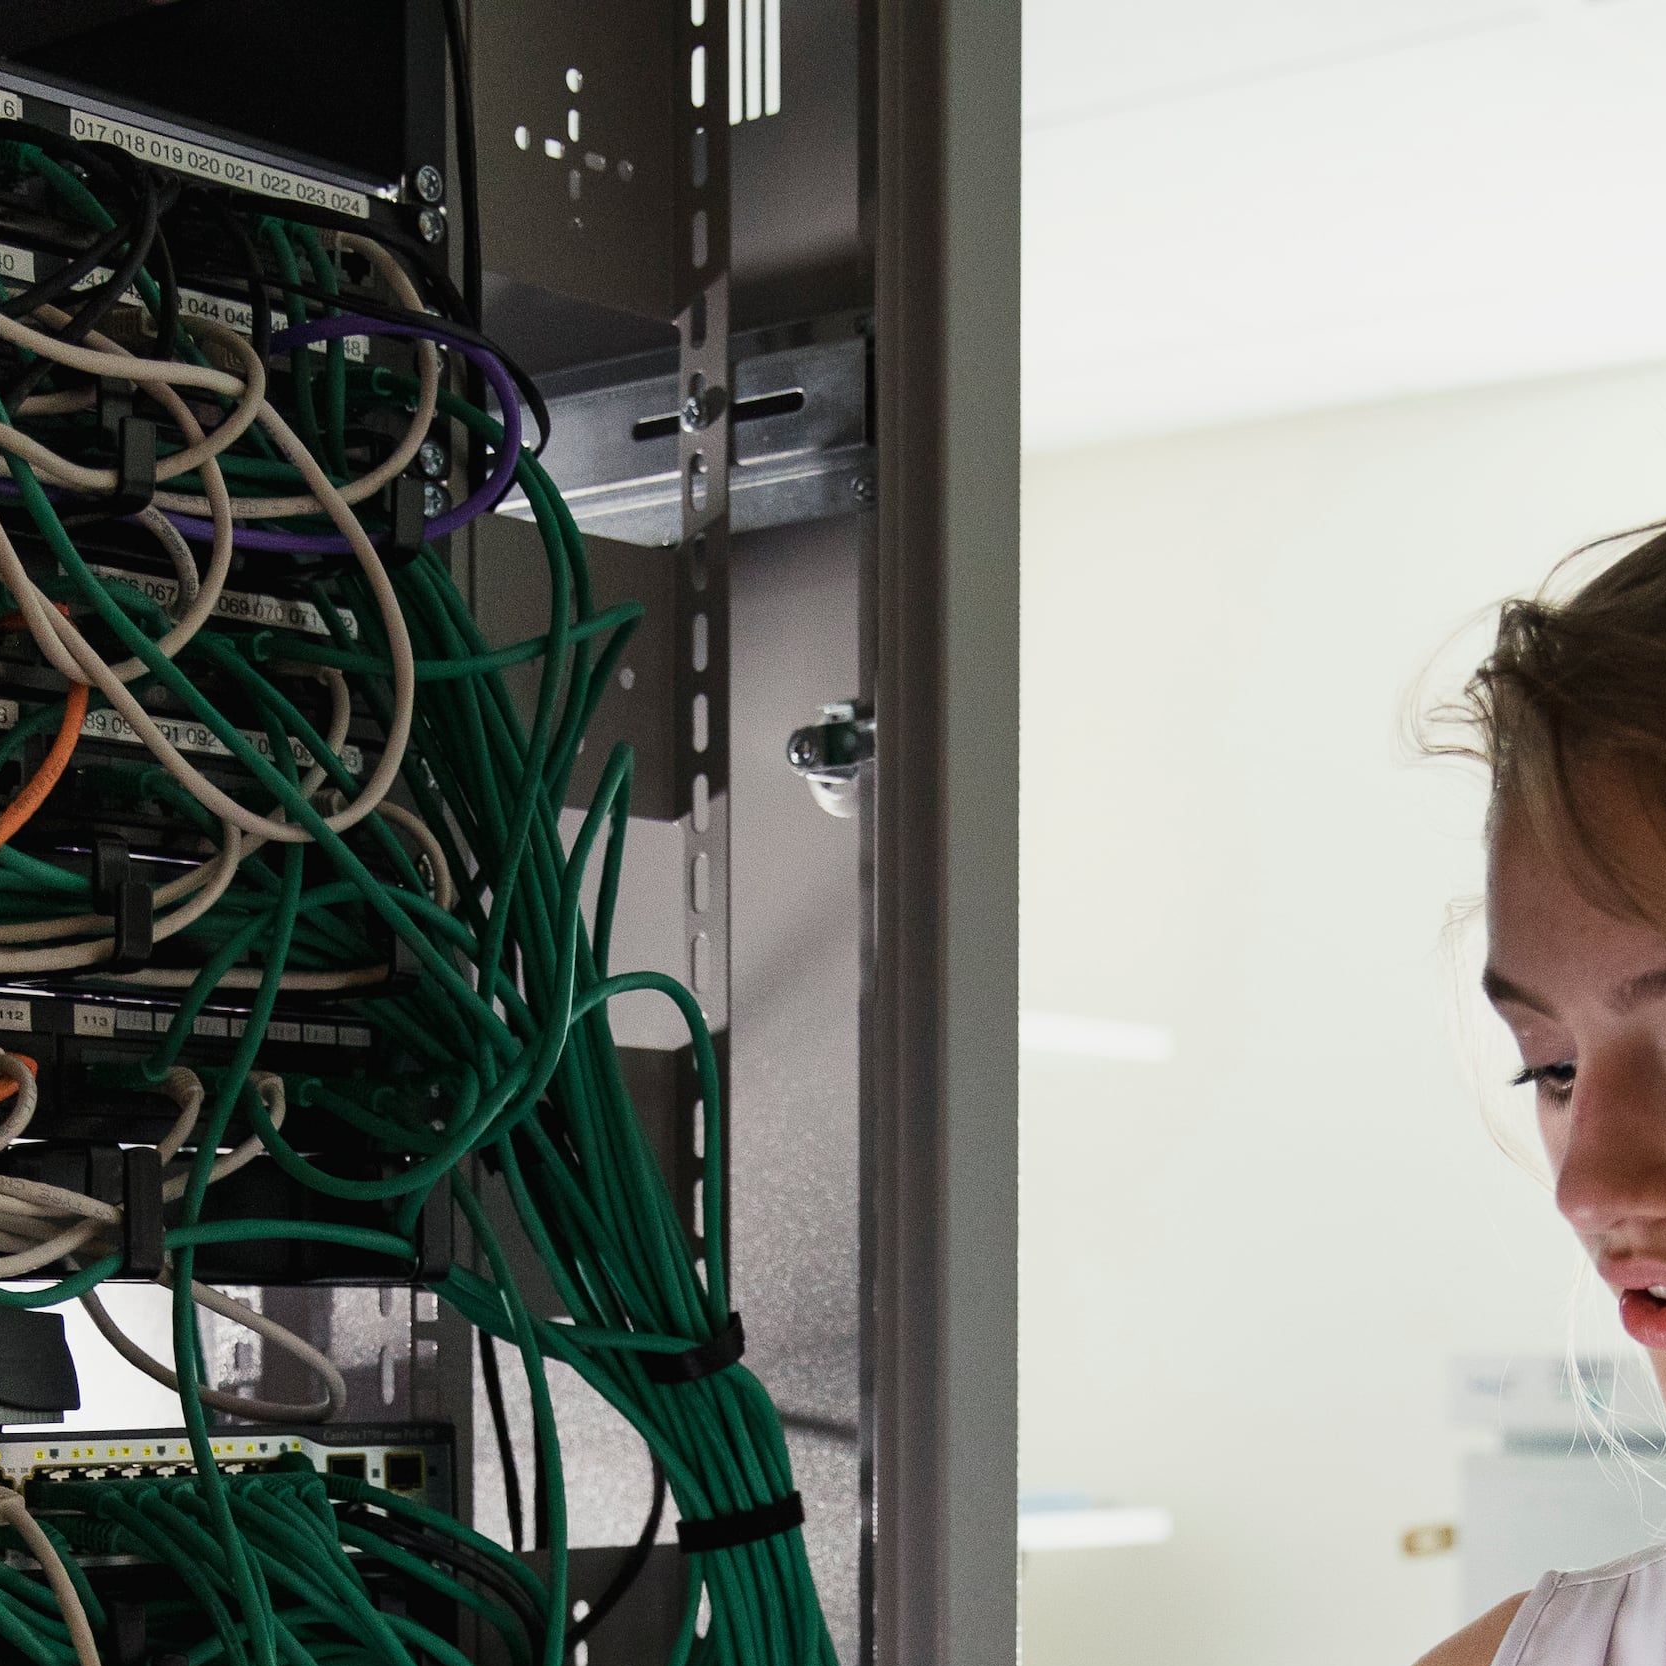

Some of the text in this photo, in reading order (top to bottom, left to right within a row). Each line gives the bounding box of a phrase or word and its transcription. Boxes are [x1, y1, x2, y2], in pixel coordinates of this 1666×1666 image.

[73, 117, 360, 215] 017 018 019 020 021 022 023 024
[188, 298, 220, 320] 044
[145, 581, 176, 603] 067
[220, 595, 249, 615] 069
[85, 713, 106, 731] 89
[82, 1014, 109, 1027] 113
